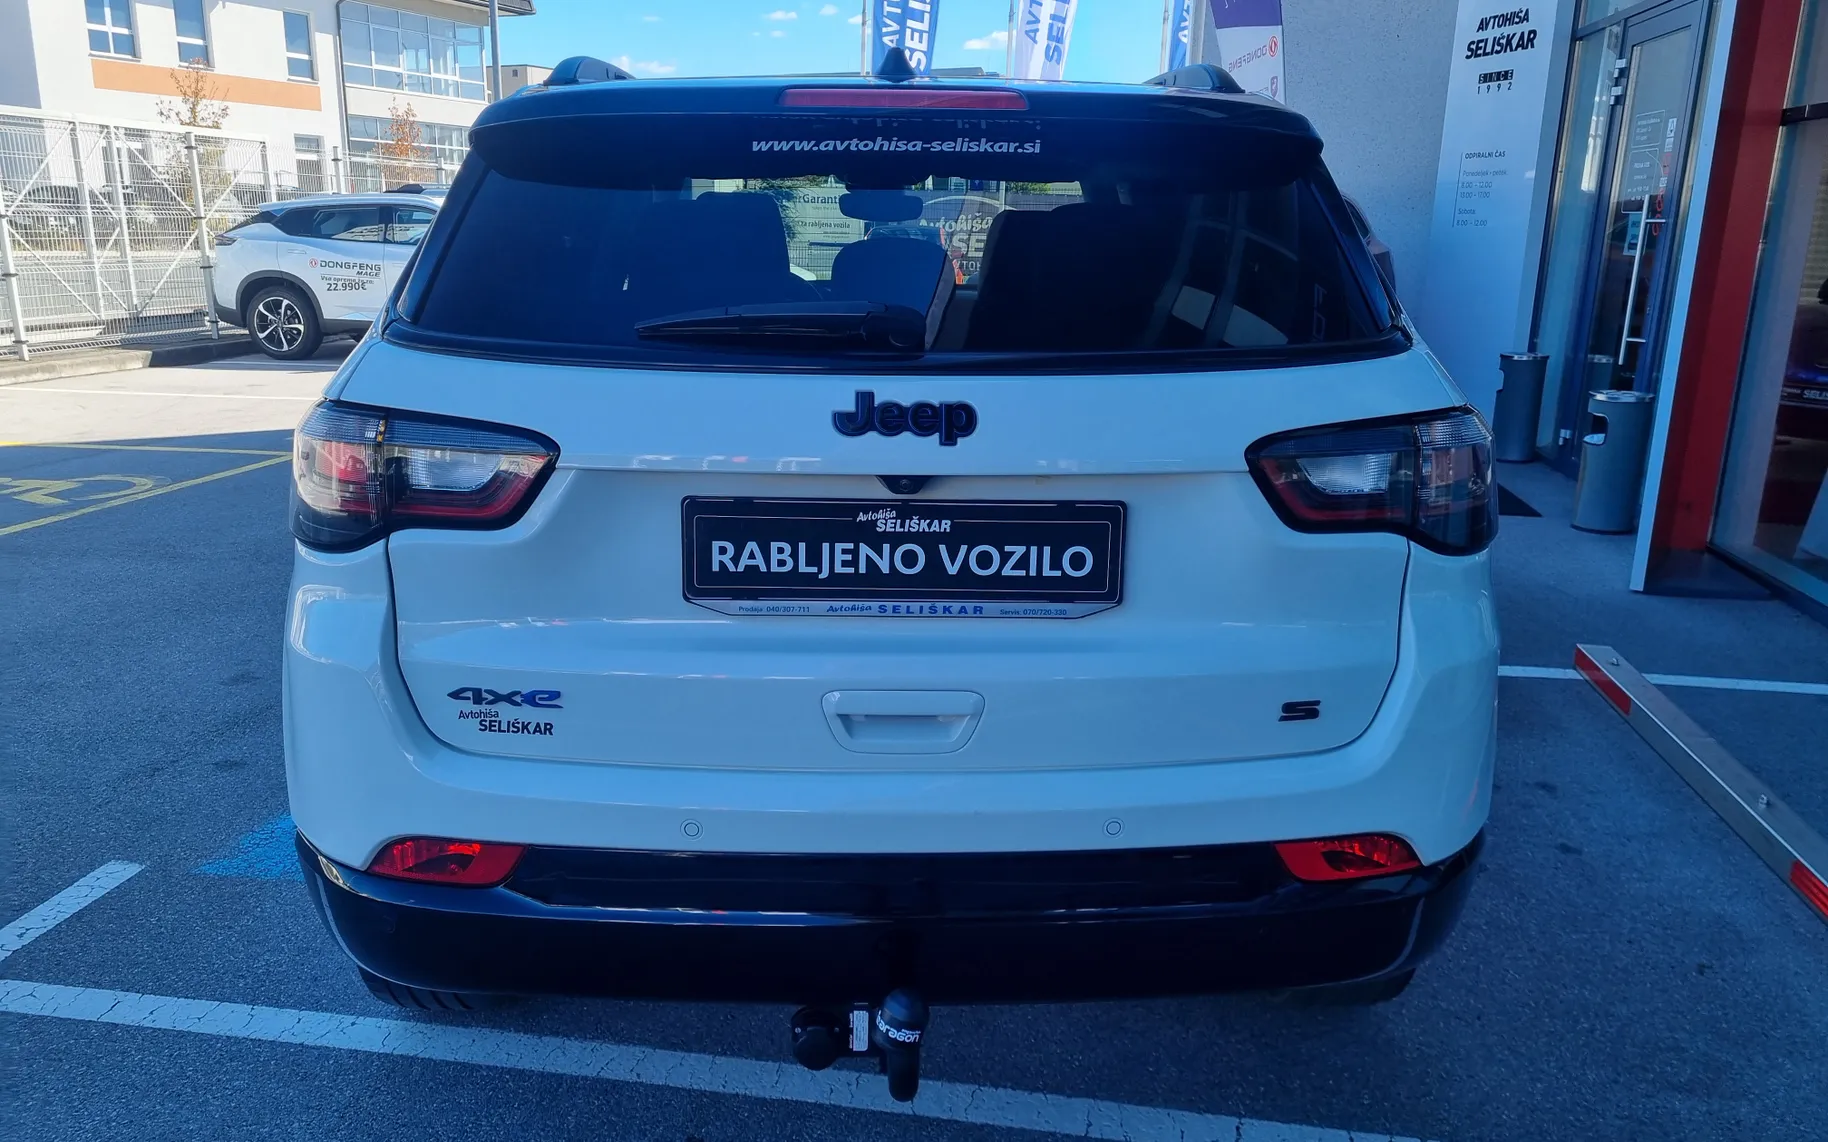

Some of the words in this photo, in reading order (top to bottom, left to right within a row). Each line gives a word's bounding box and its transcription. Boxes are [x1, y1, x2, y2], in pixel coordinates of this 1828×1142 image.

[1476, 7, 1530, 33] AVTOHIŠA
[1464, 29, 1538, 60] SELIŠKAR
[1479, 69, 1514, 84] SINCE
[752, 136, 1041, 154] www.avtohisa-seliskar.si
[1464, 151, 1494, 160] ODPIRALNI
[1494, 149, 1506, 158] ČAS
[808, 220, 832, 229] rabljena
[833, 221, 851, 229] vozila
[320, 260, 381, 272] DONGFENG
[326, 282, 367, 292] 22.990€
[832, 390, 978, 446] Jeep
[856, 508, 897, 522] Avtohiša
[876, 516, 952, 533] SELIŠKAR
[711, 541, 926, 579] RABLJENO
[938, 544, 1094, 577] VOZILO
[826, 603, 872, 613] Avtohiša
[877, 603, 984, 615] SELIŠKAR
[1022, 608, 1067, 616] 070/720-330
[446, 687, 564, 709] 4xe
[458, 709, 500, 720] Avtohiša
[1278, 699, 1321, 722] S
[478, 718, 554, 736] SELIŠKAR
